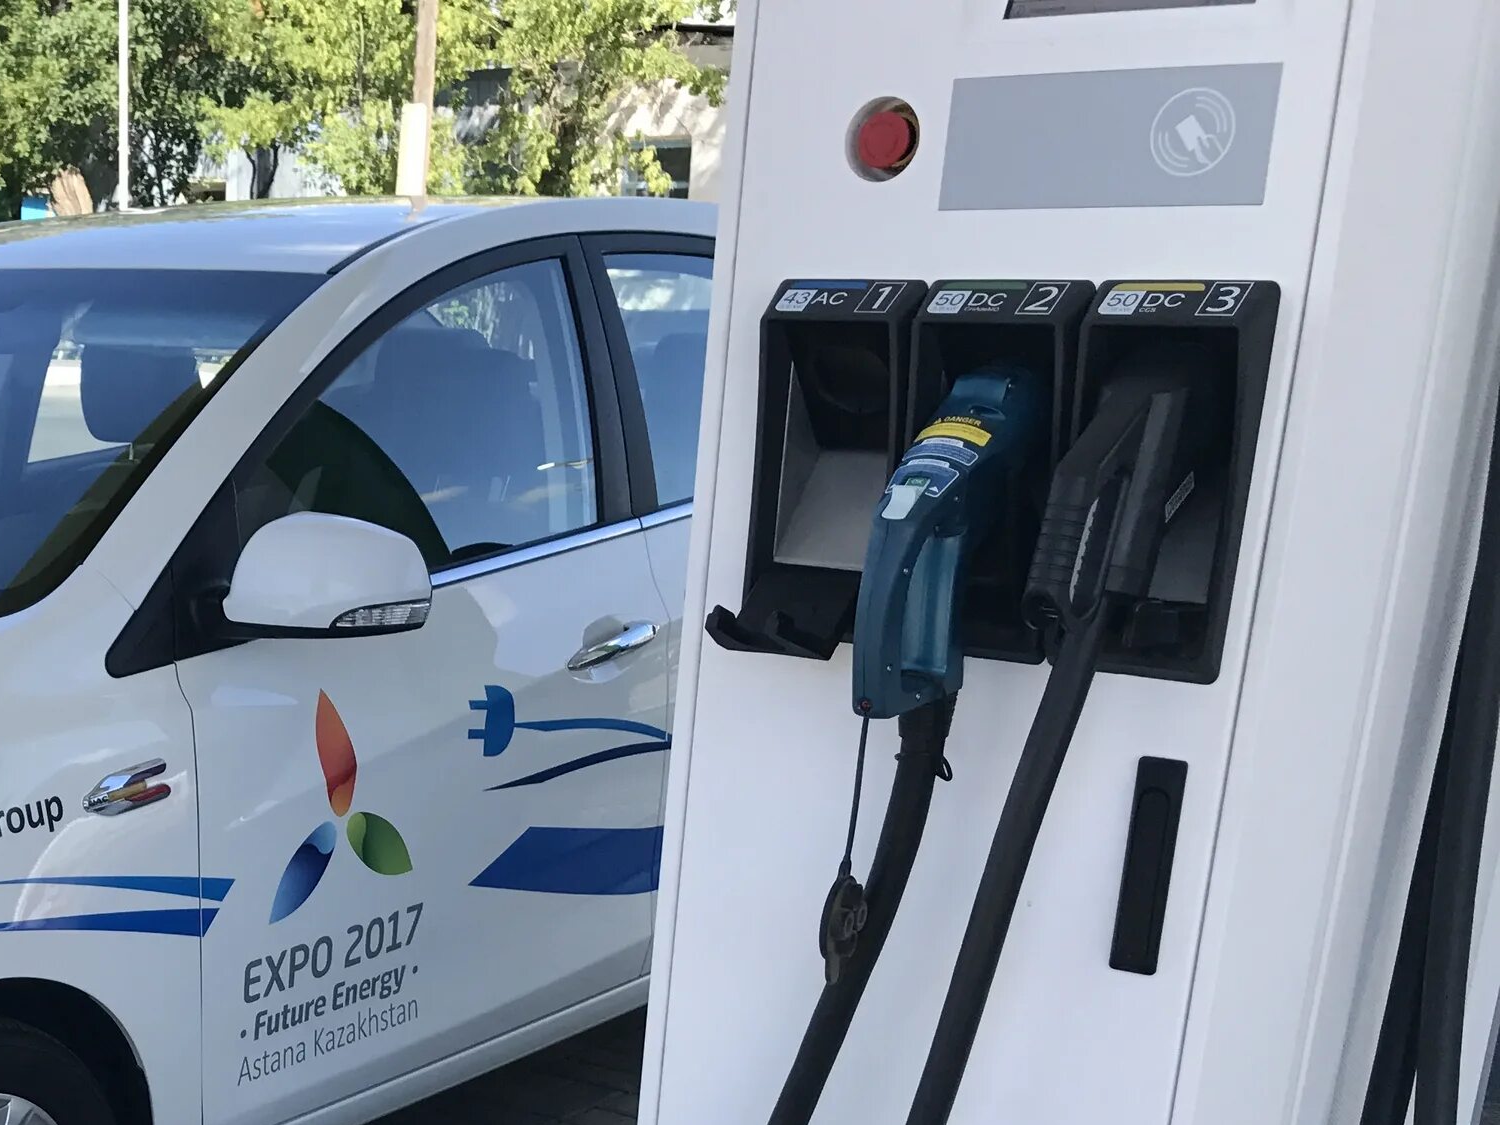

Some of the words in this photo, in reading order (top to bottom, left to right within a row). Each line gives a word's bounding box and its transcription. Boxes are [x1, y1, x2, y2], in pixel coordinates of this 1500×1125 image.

[783, 291, 811, 305] 43
[810, 291, 848, 305] AC
[871, 285, 893, 310] 1
[935, 293, 966, 306] 50
[967, 292, 1008, 307] DC
[1023, 286, 1059, 312] 2
[1107, 293, 1140, 307] 50
[1142, 293, 1186, 308] DC
[1205, 286, 1241, 312] 3
[944, 416, 982, 426] DANGER
[243, 935, 333, 1004] EXPO
[344, 902, 424, 969] 2017
[253, 995, 327, 1041] Future
[332, 964, 406, 1011] Energy
[237, 1041, 306, 1086] Astana
[314, 999, 418, 1057] Kazakhstan
